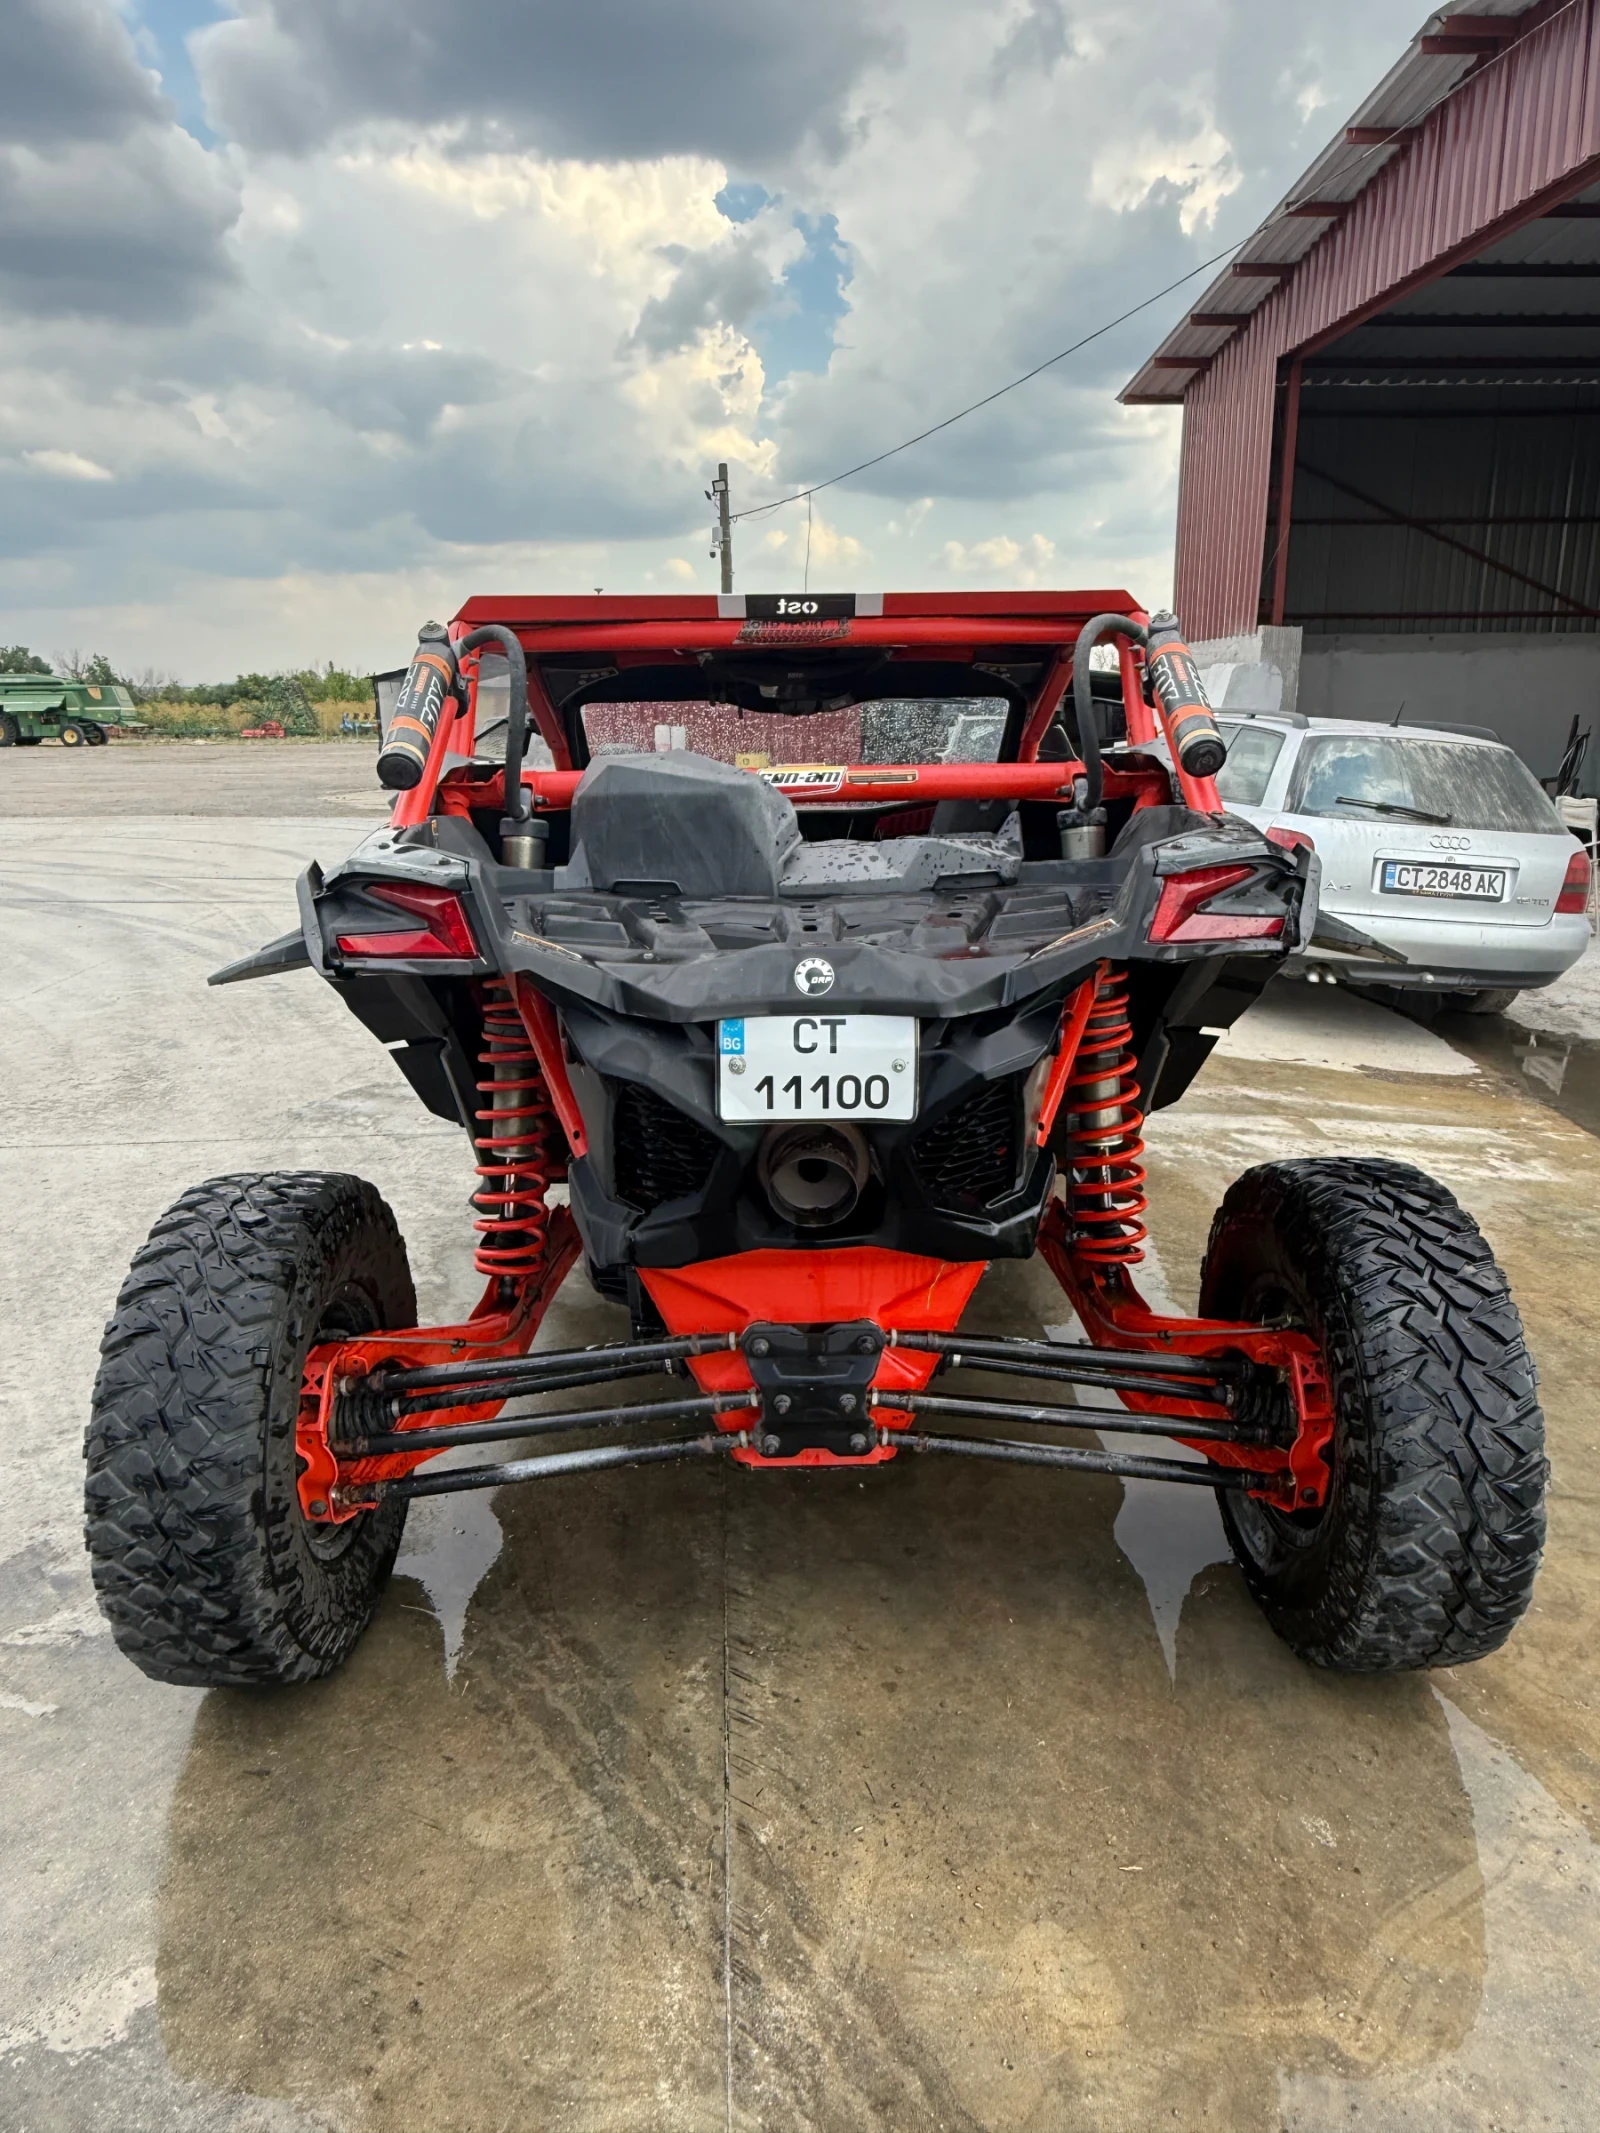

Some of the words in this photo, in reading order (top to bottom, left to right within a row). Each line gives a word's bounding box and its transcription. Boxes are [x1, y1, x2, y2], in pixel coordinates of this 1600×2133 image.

[1397, 867, 1423, 888] CT
[1424, 869, 1472, 891] 2848
[1475, 873, 1500, 894] AK
[723, 1037, 741, 1051] BG
[793, 1018, 847, 1054] CT
[754, 1074, 890, 1110] 11100
